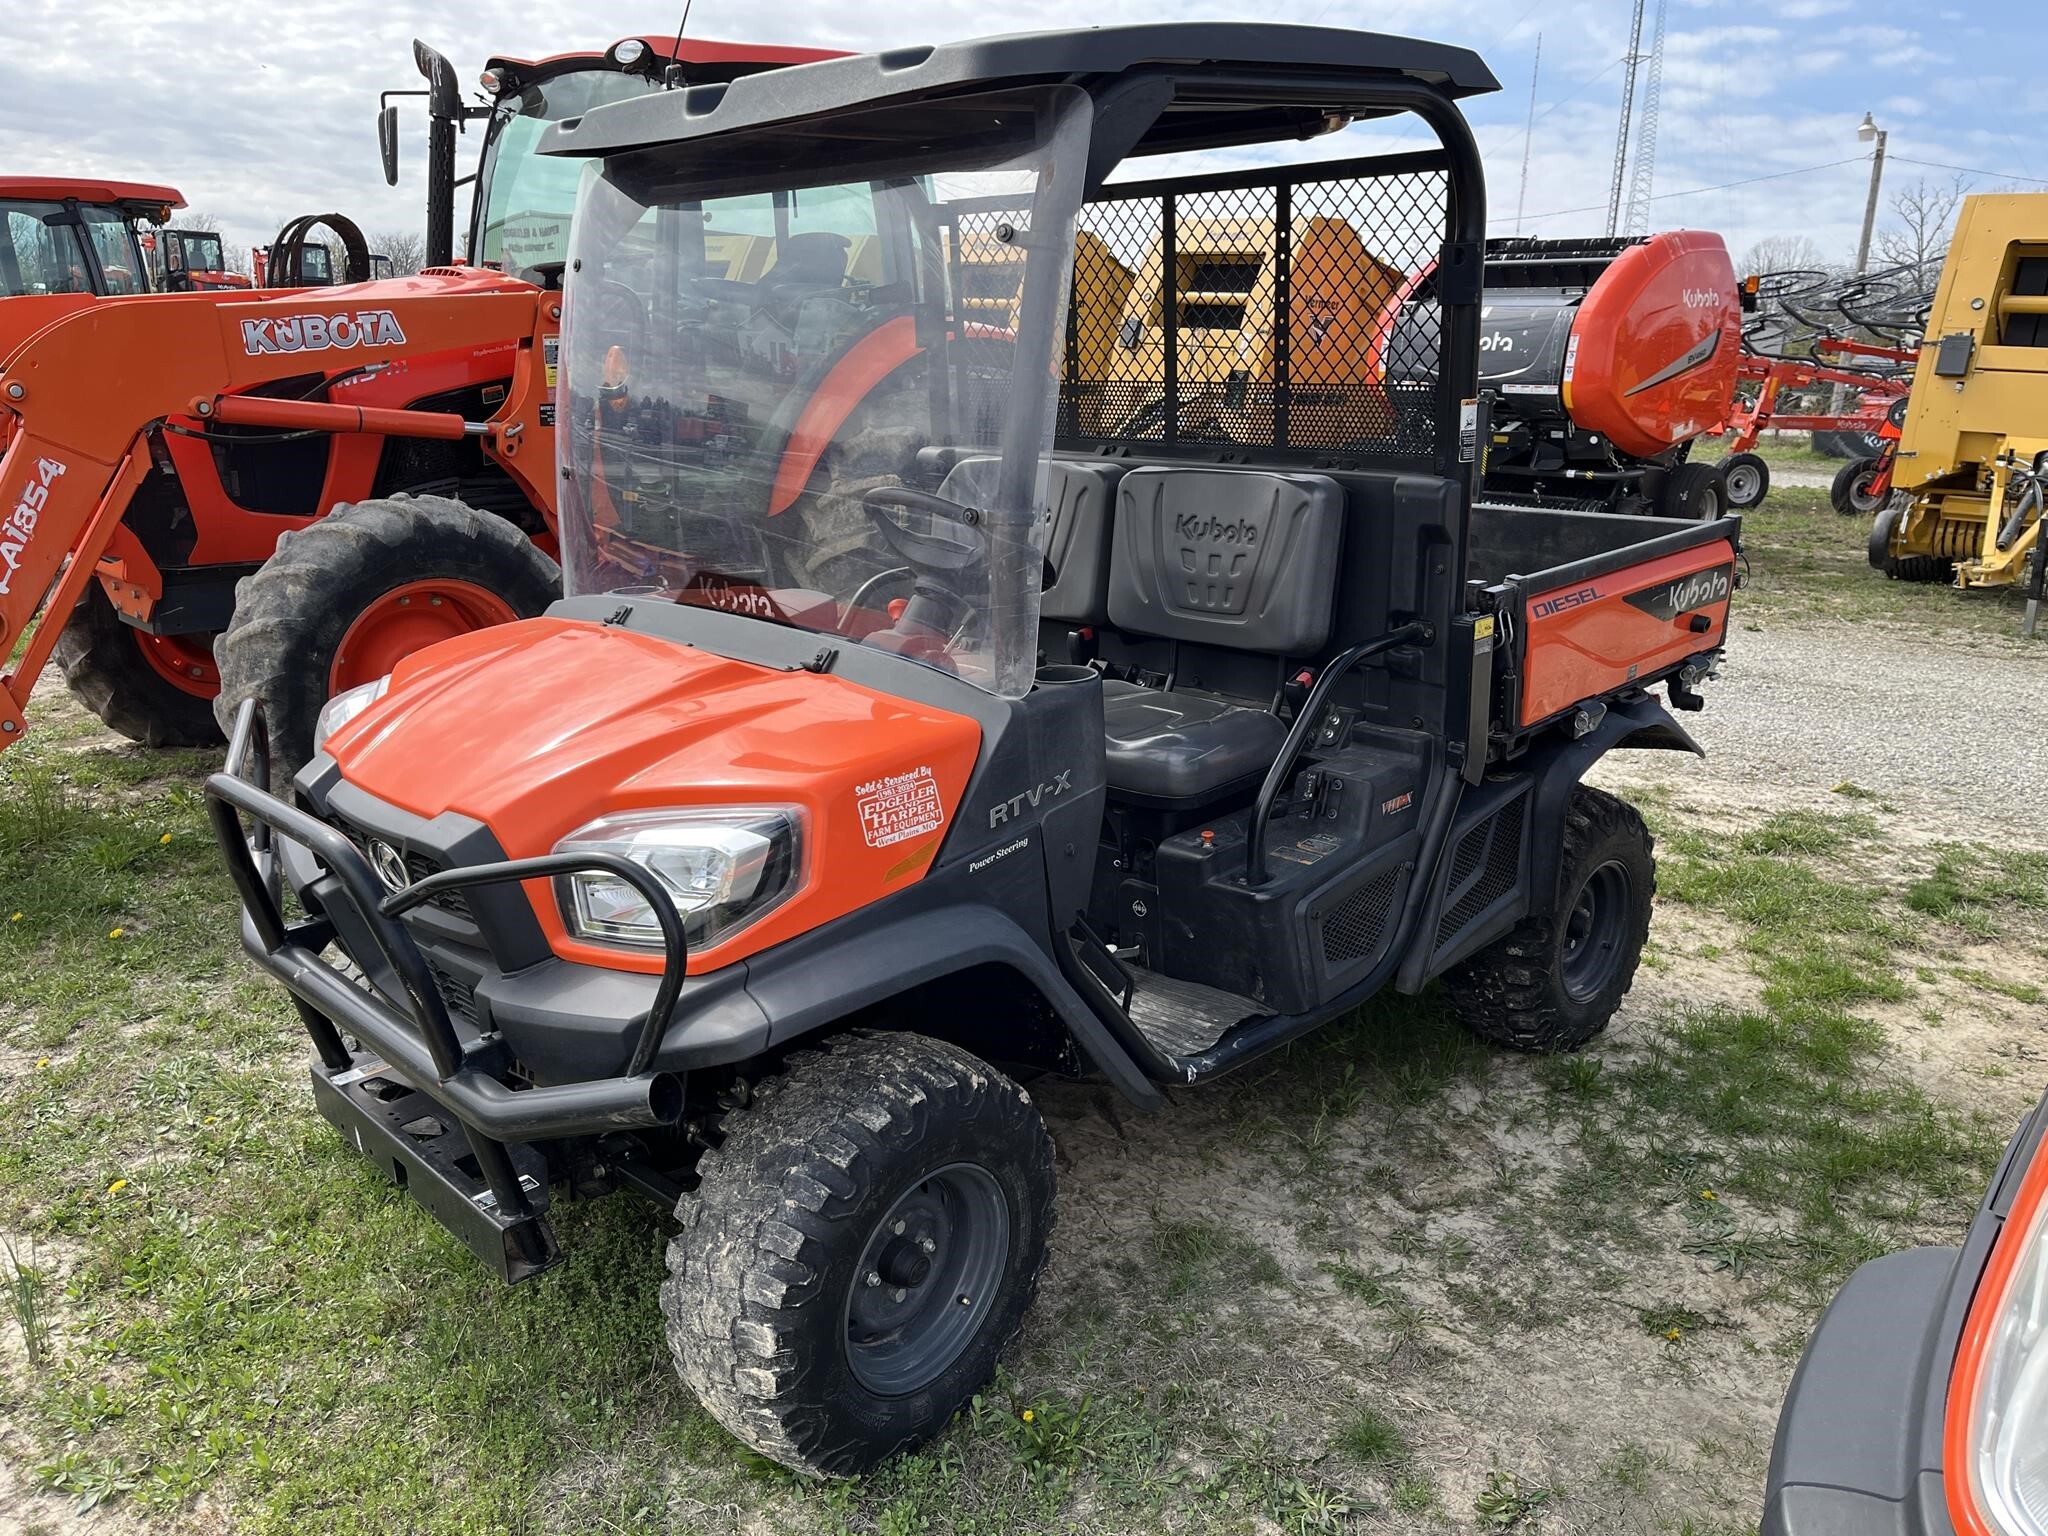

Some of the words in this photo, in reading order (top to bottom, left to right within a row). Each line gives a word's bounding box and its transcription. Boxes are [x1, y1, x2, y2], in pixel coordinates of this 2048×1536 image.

[1682, 288, 1719, 308] Kubota
[241, 310, 406, 355] KUBOTA
[1175, 513, 1257, 547] Kubota
[699, 576, 775, 617] Kubota
[1532, 587, 1606, 619] DIESEL
[1669, 571, 1728, 611] Kubota
[855, 781, 876, 796] Sold
[884, 768, 920, 787] Serviced
[920, 766, 932, 777] By
[878, 783, 914, 798] 1981-2024
[863, 785, 935, 820] EDGELLER
[898, 799, 921, 811] AND
[989, 768, 1072, 829] RTV-X
[868, 825, 891, 840] FARM
[894, 809, 940, 831] EQUIPMENT
[873, 801, 936, 829] HARPER
[878, 835, 896, 847] West
[969, 854, 995, 872] Power
[996, 838, 1028, 859] Steering
